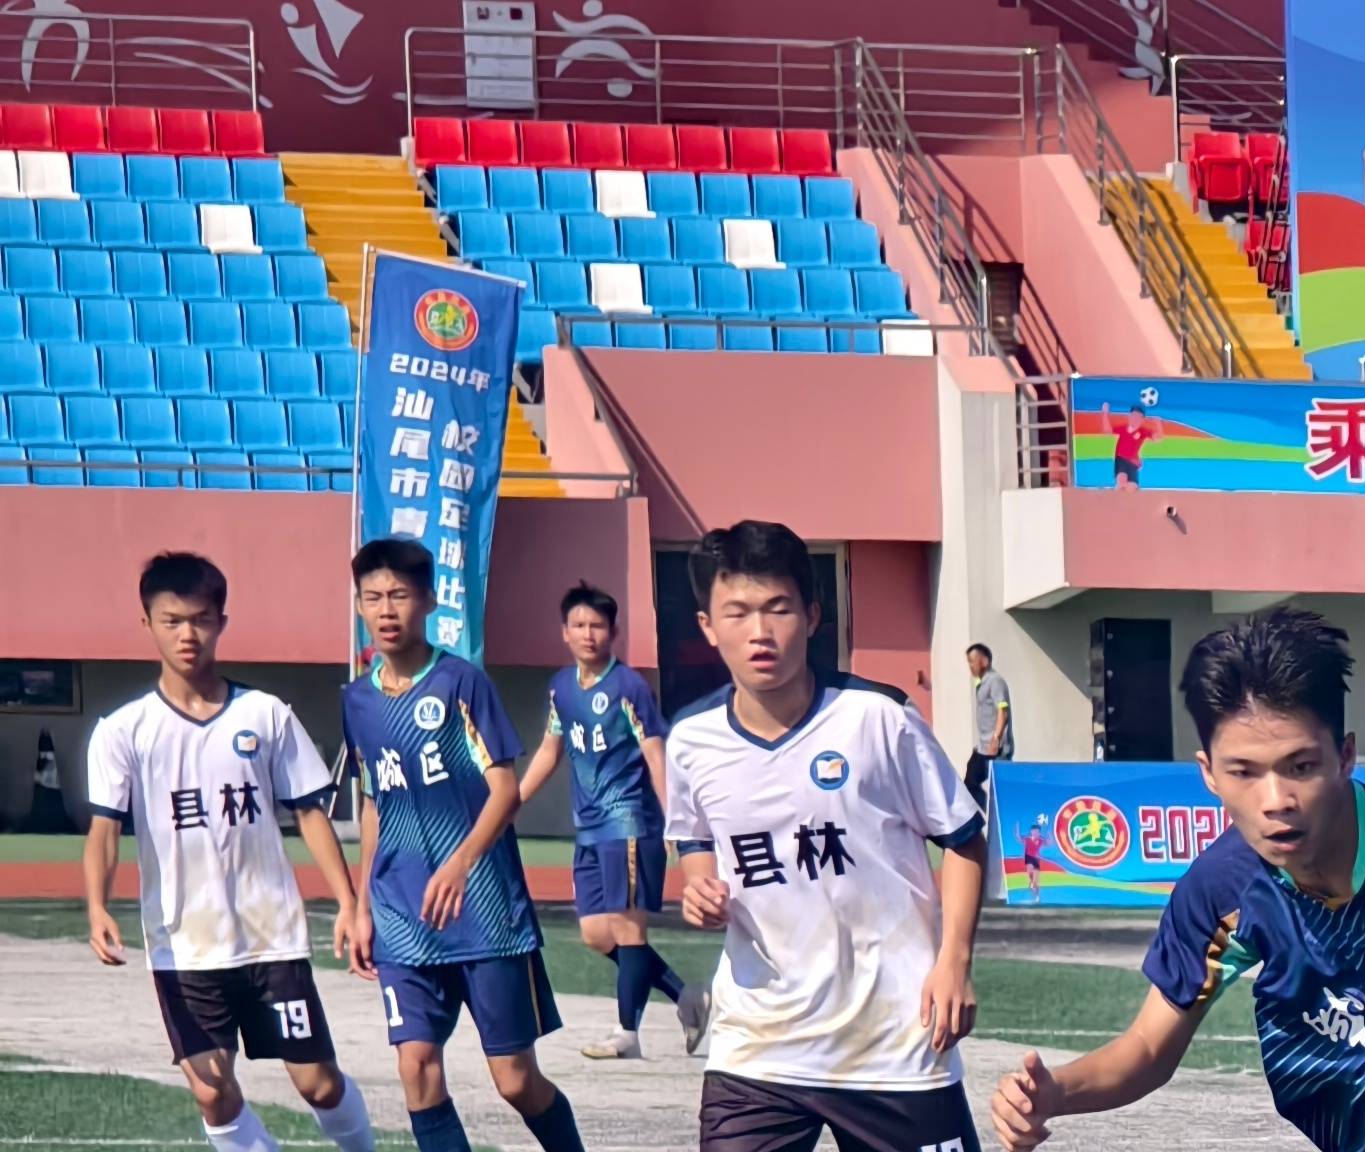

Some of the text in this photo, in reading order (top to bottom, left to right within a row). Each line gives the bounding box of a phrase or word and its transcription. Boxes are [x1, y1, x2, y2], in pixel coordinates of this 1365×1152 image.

[389, 352, 491, 394] 2024年
[437, 418, 481, 650] 校园足球比赛
[376, 740, 450, 792] 城区
[170, 781, 262, 831] 县林
[730, 821, 857, 889] 县林
[1138, 805, 1232, 864] 202
[272, 998, 313, 1040] 19
